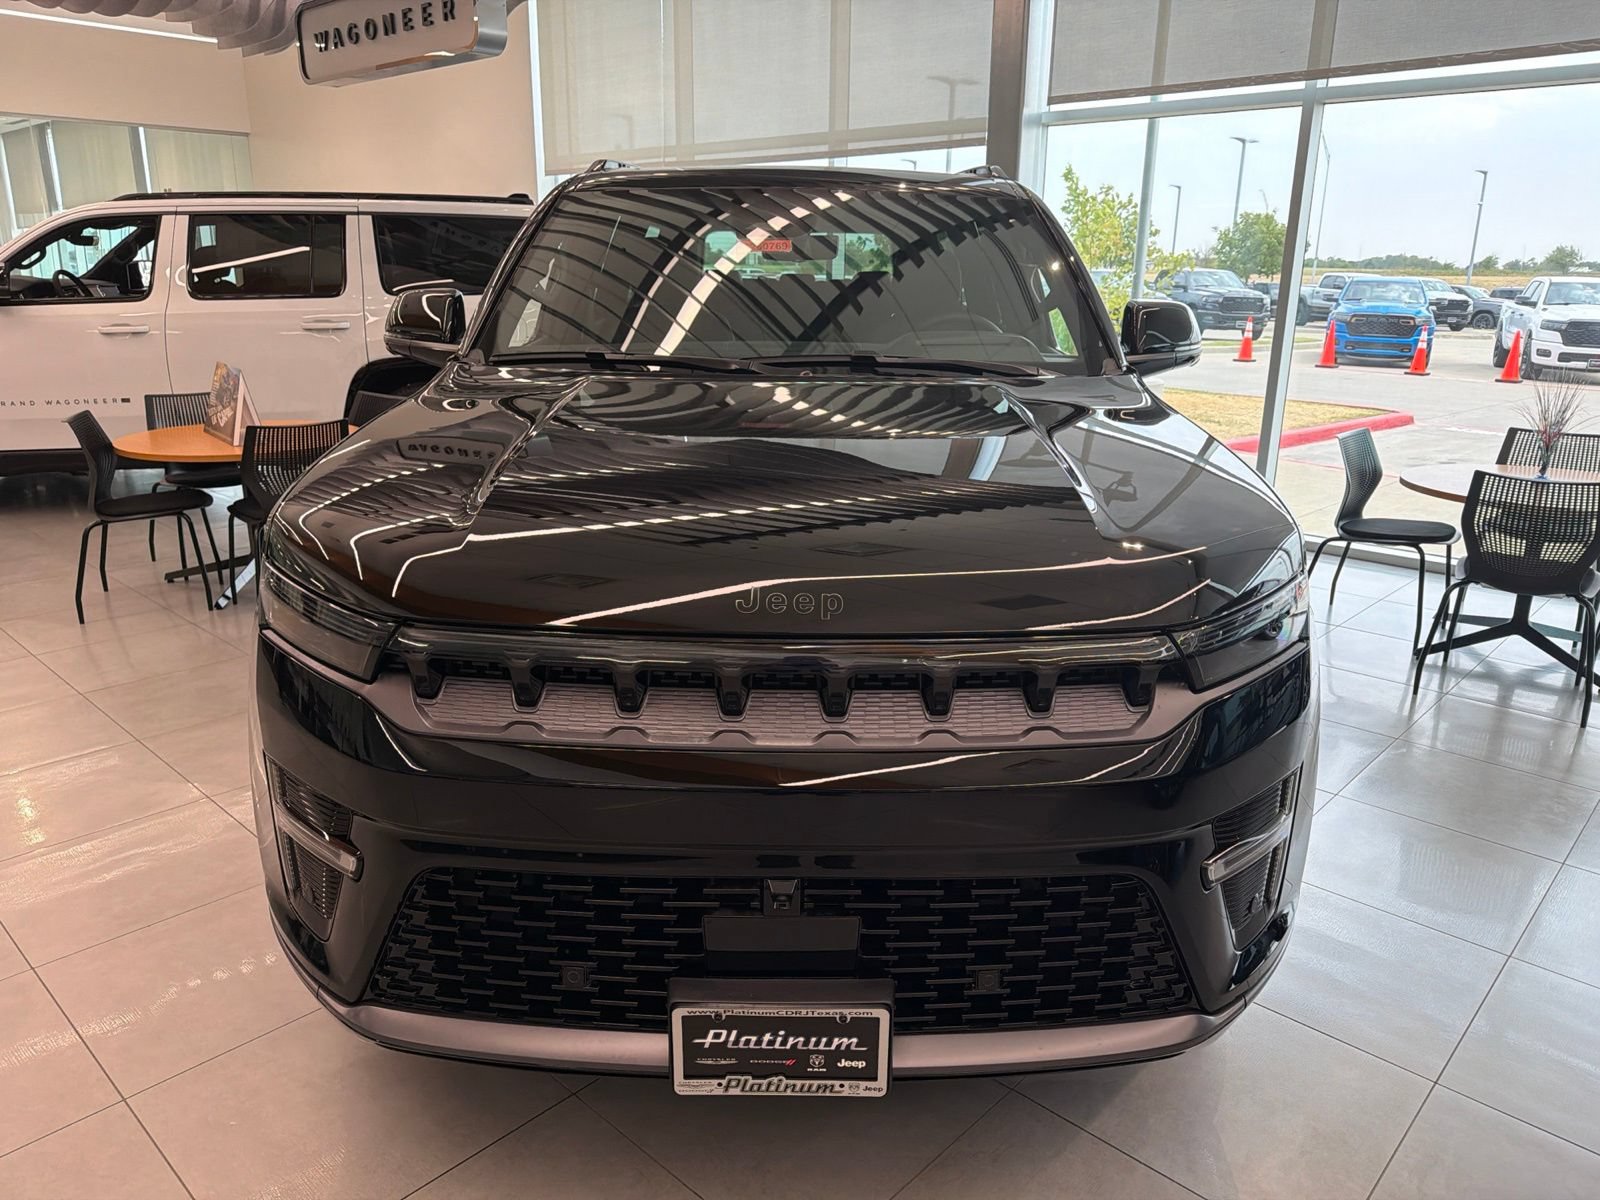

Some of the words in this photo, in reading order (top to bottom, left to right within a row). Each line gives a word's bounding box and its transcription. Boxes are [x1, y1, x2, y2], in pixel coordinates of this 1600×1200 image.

[313, 0, 456, 53] WAGONEER
[757, 241, 788, 251] 0769
[45, 397, 118, 406] WAGONEER
[735, 586, 844, 621] Jeep
[692, 1029, 869, 1051] Platinum
[837, 1058, 867, 1069] Jeep
[722, 1077, 845, 1095] Platinum
[862, 1085, 884, 1093] Jeep
